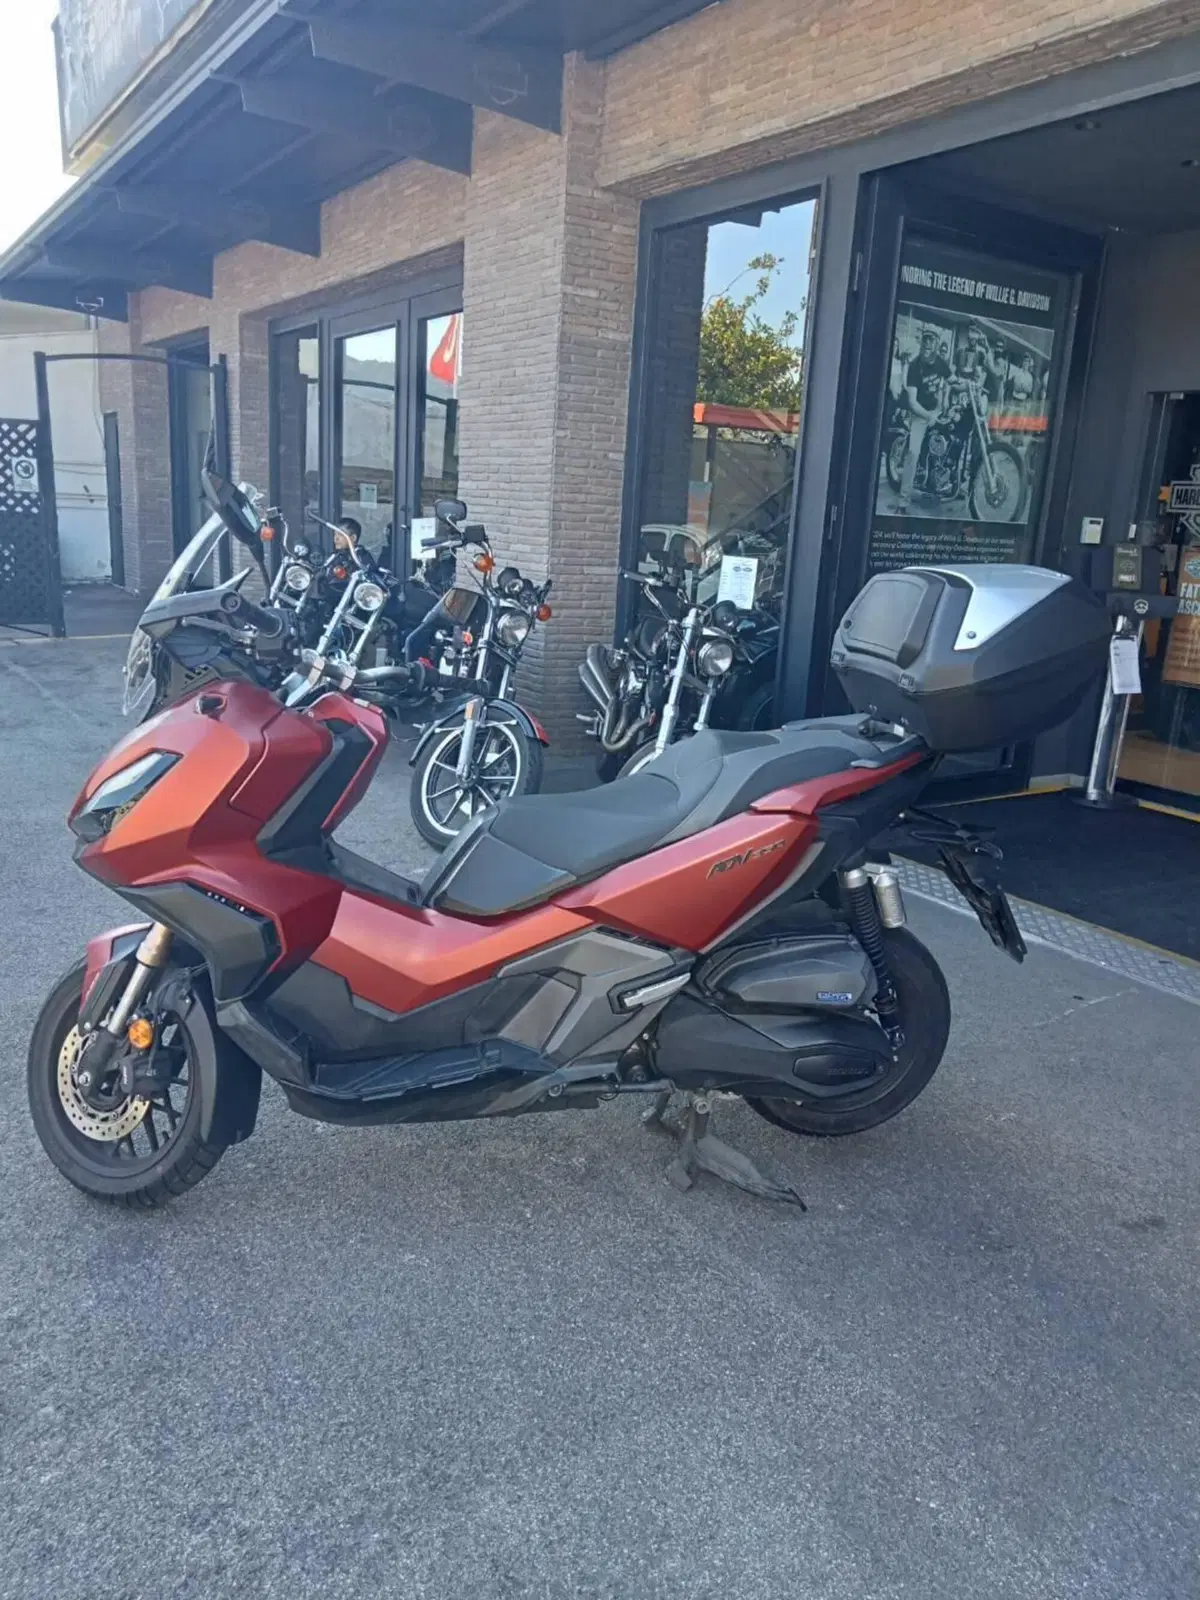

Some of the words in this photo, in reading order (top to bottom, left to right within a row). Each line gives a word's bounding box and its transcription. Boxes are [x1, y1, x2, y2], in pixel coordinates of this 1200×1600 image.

[933, 271, 948, 291] THE
[947, 275, 976, 297] LEGEND
[975, 281, 987, 298] OF
[986, 284, 1010, 304] WILLIE
[1009, 288, 1017, 305] G.
[1017, 290, 1051, 311] DAVIDSON
